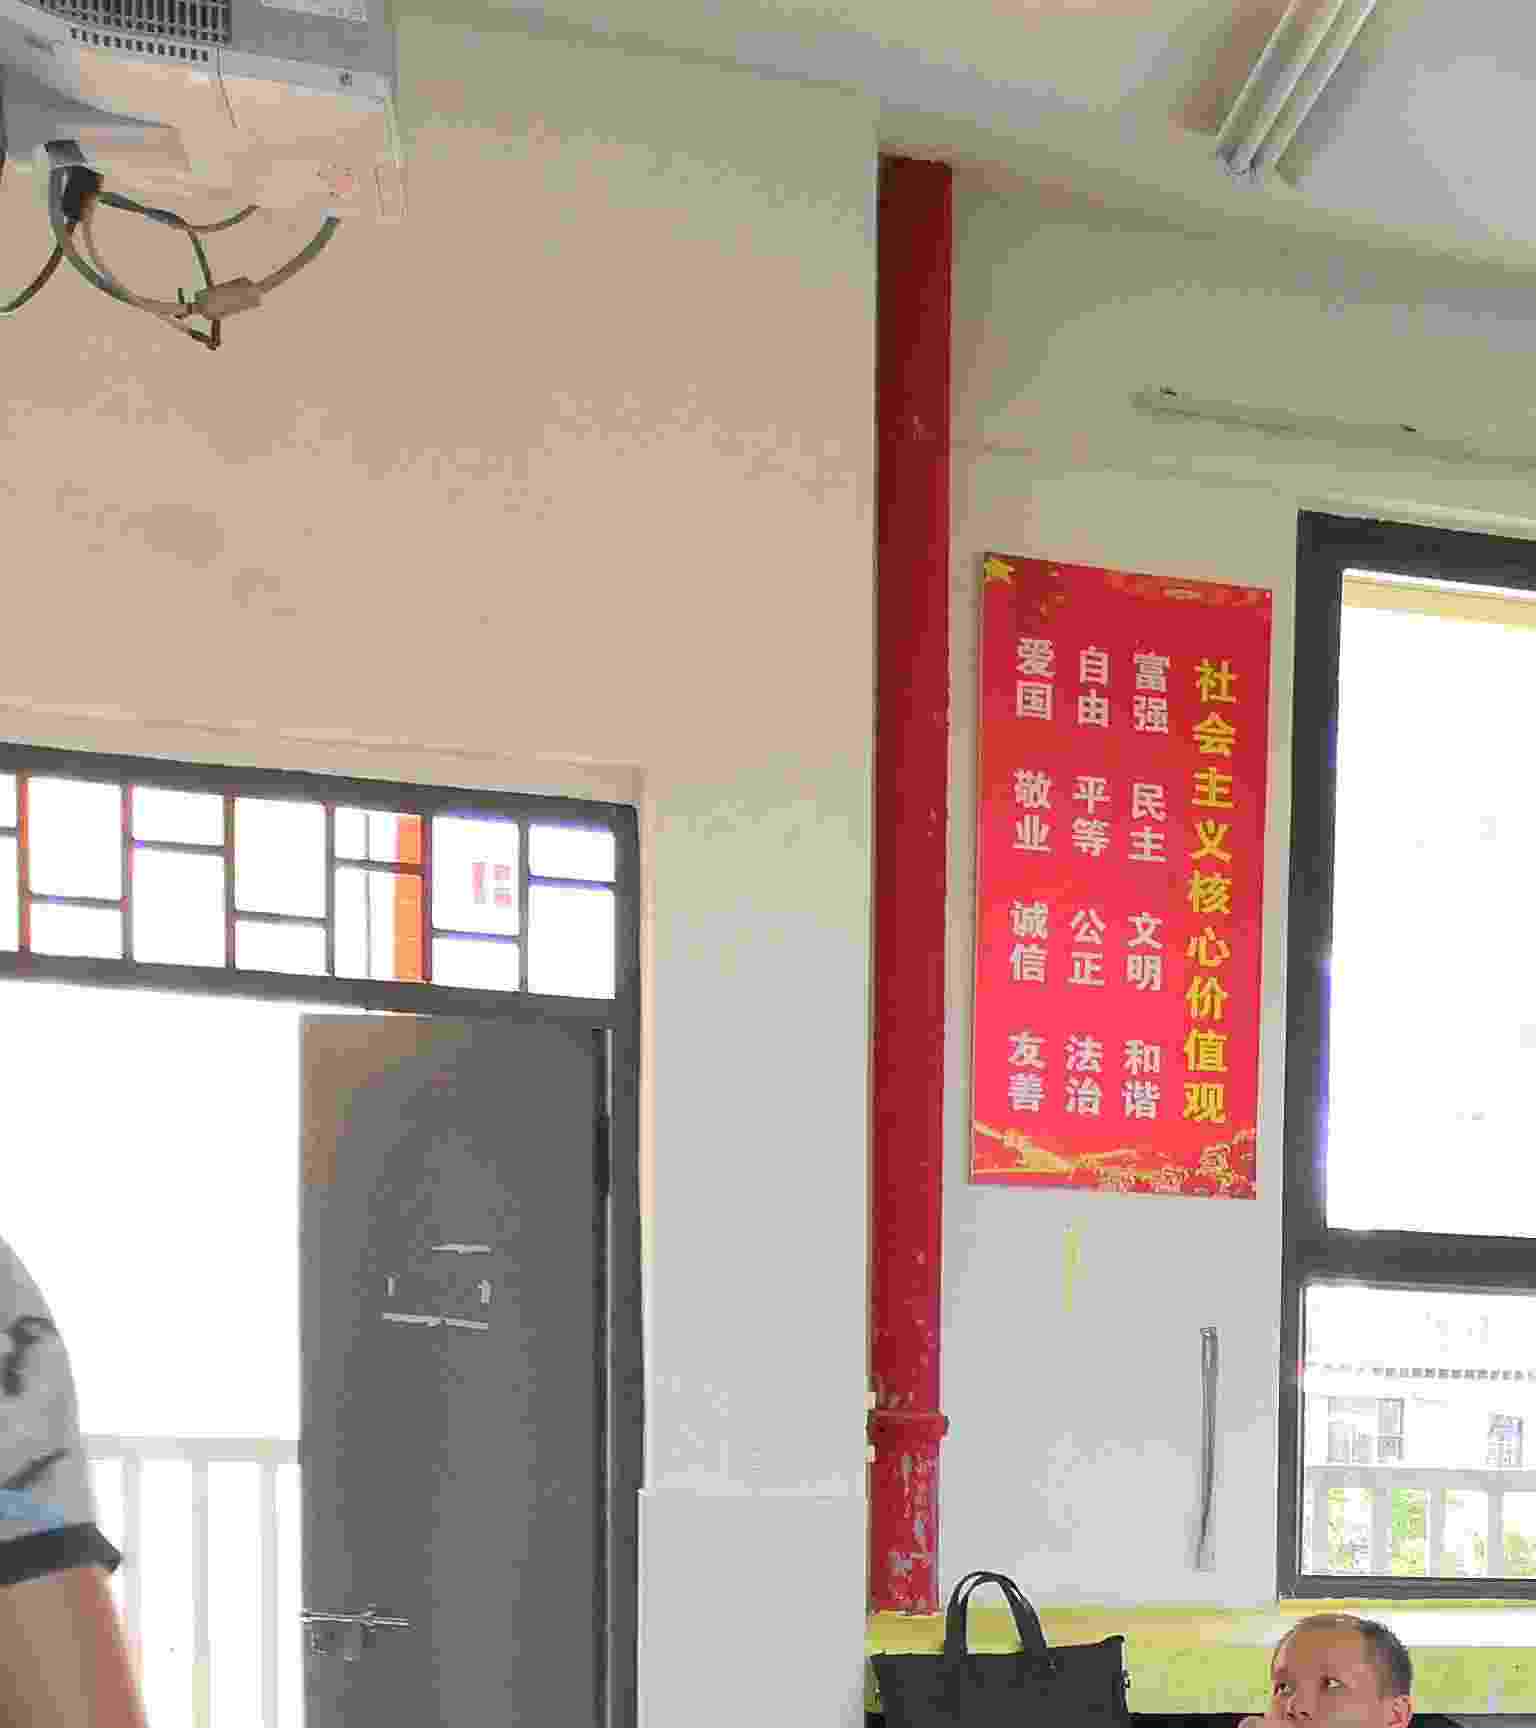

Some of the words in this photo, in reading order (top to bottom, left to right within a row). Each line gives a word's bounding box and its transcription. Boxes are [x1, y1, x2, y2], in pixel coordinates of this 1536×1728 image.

[1015, 638, 1056, 721] 爱国
[1076, 645, 1112, 728] 自由
[1133, 650, 1170, 735] 富强
[1012, 769, 1053, 854] 敬业
[1071, 776, 1110, 858] 平等
[1129, 783, 1168, 862] 民主
[1184, 658, 1239, 1124] 社会主义核心价值观
[1009, 900, 1049, 984] 诚信
[1068, 908, 1106, 989] 公正
[1127, 911, 1162, 991] 文明
[1007, 1031, 1046, 1113] 友善
[1064, 1033, 1103, 1117] 法治
[1121, 1038, 1161, 1121] 和谐
